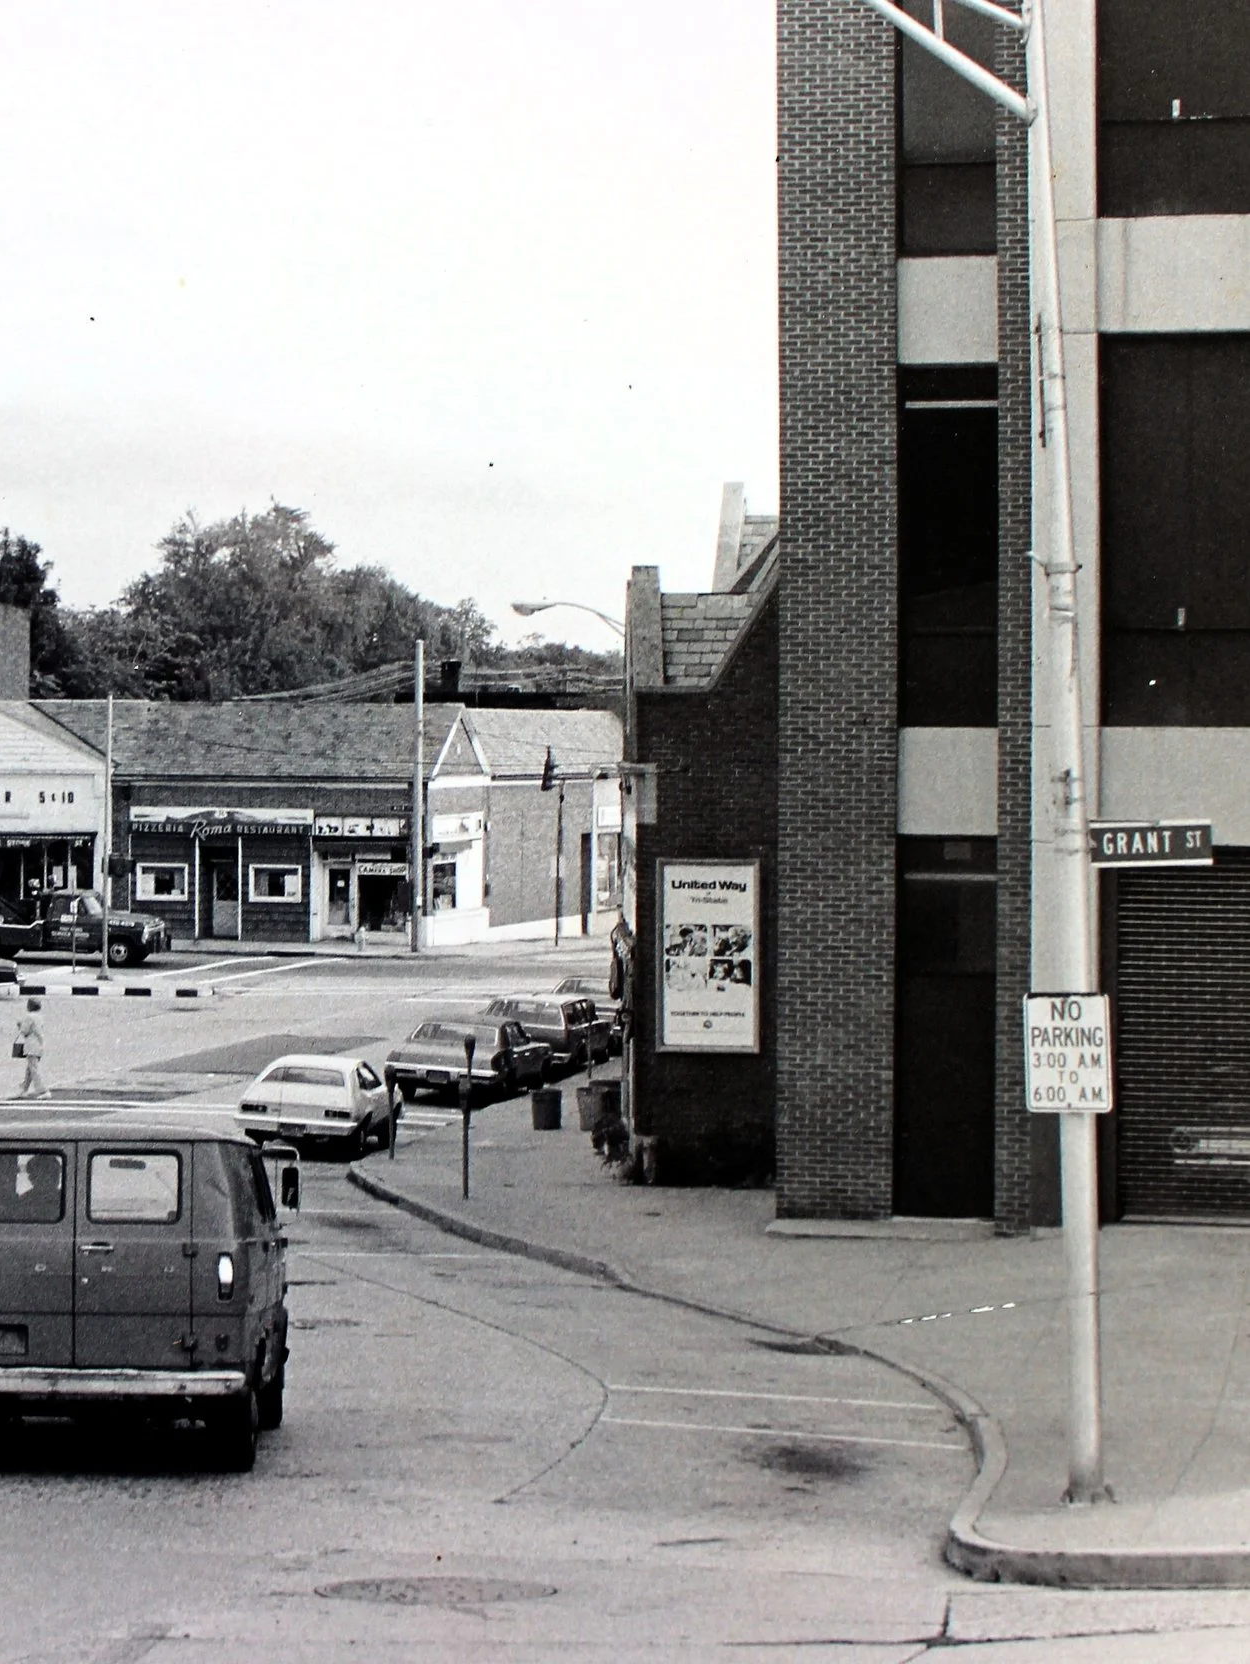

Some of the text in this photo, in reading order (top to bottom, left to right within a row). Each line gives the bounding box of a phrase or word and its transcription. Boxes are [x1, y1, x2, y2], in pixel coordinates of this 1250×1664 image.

[131, 822, 185, 833] PIZZERIA
[189, 817, 233, 841] Roma
[236, 825, 304, 835] RESTAURANT
[1102, 829, 1203, 855] GRANT ST
[671, 880, 747, 893] United Way
[1050, 1000, 1082, 1021] NO
[1031, 1026, 1104, 1048] PARKING
[1057, 1070, 1079, 1085] TO
